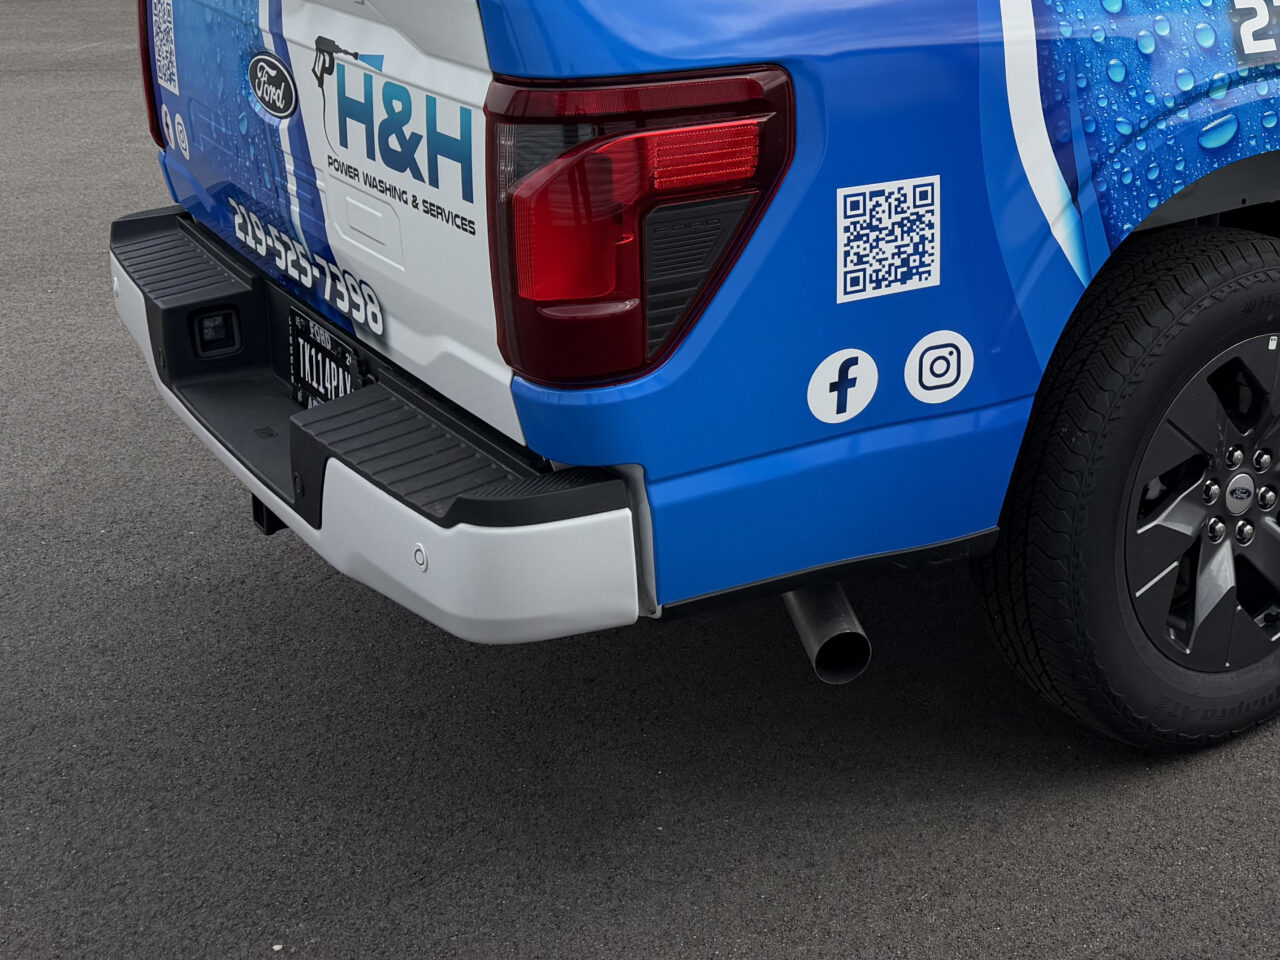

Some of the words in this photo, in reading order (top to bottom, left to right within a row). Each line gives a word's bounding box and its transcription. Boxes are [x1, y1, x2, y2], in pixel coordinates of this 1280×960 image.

[255, 61, 285, 109] Ford
[336, 63, 474, 203] H&H
[327, 155, 360, 183] POWER
[362, 172, 409, 206] WASHING
[411, 194, 421, 208] &
[422, 197, 476, 236] SERVICES
[233, 198, 384, 336] 219-525-7398
[309, 321, 331, 350] FORD
